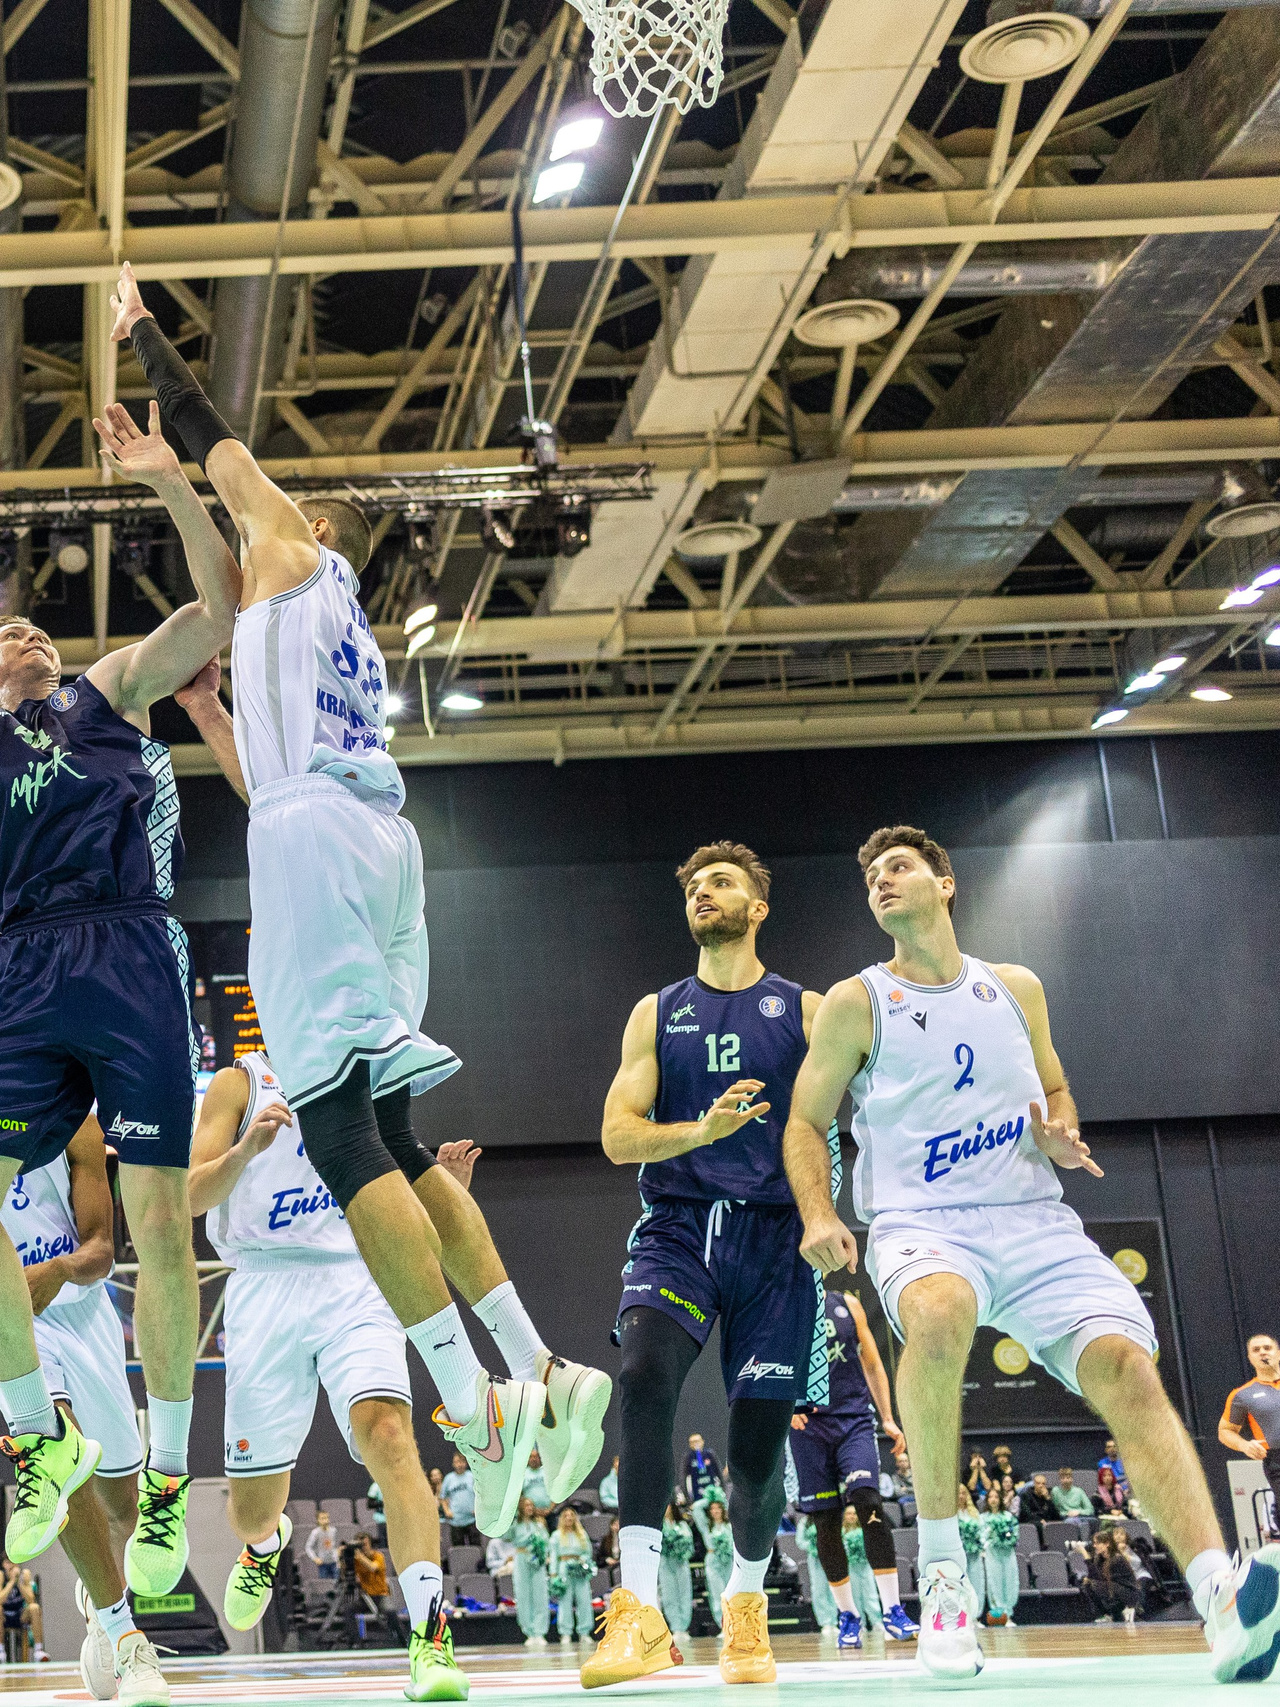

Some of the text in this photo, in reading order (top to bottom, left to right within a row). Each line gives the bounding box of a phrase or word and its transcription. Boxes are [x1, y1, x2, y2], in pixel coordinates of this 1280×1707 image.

[666, 1024, 700, 1034] Kempa
[705, 1033, 741, 1072] 12
[953, 1043, 975, 1092] 2
[923, 1116, 1025, 1183] Enisey
